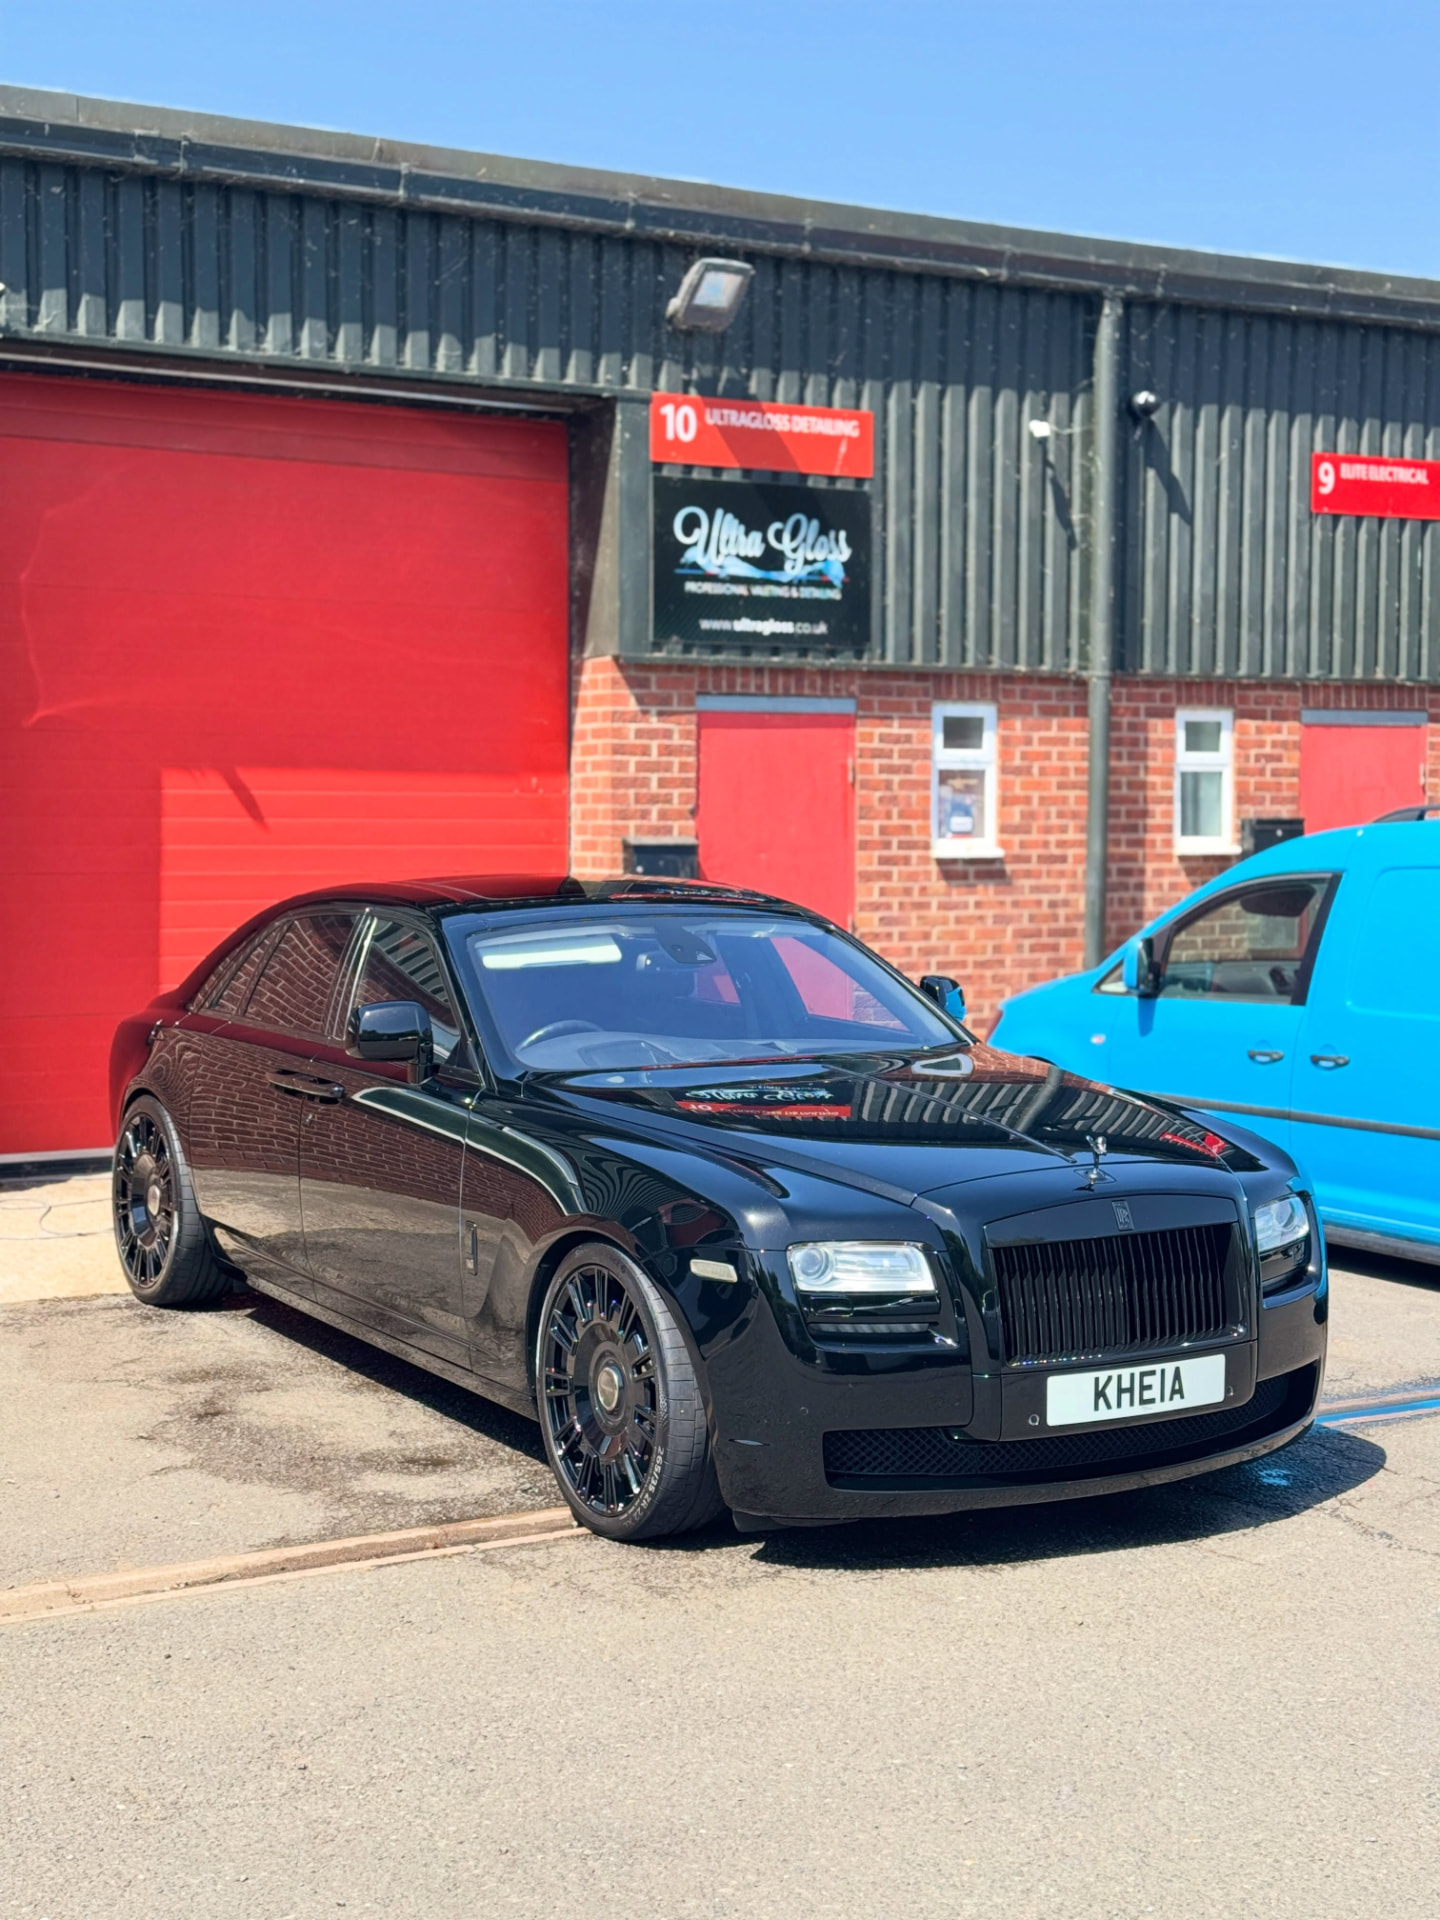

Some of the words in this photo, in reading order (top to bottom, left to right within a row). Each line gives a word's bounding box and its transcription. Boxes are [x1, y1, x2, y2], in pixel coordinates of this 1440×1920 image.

[660, 403, 697, 442] 10
[705, 407, 791, 432] ULTRAGLOSS
[792, 415, 860, 437] DETAILING
[1318, 461, 1335, 495] 9
[1340, 462, 1367, 481] ELITE
[1368, 464, 1429, 485] ELECTRICAL
[673, 506, 765, 566] Ultra
[767, 513, 852, 573] Gloss
[648, 1445, 665, 1493] 265/35
